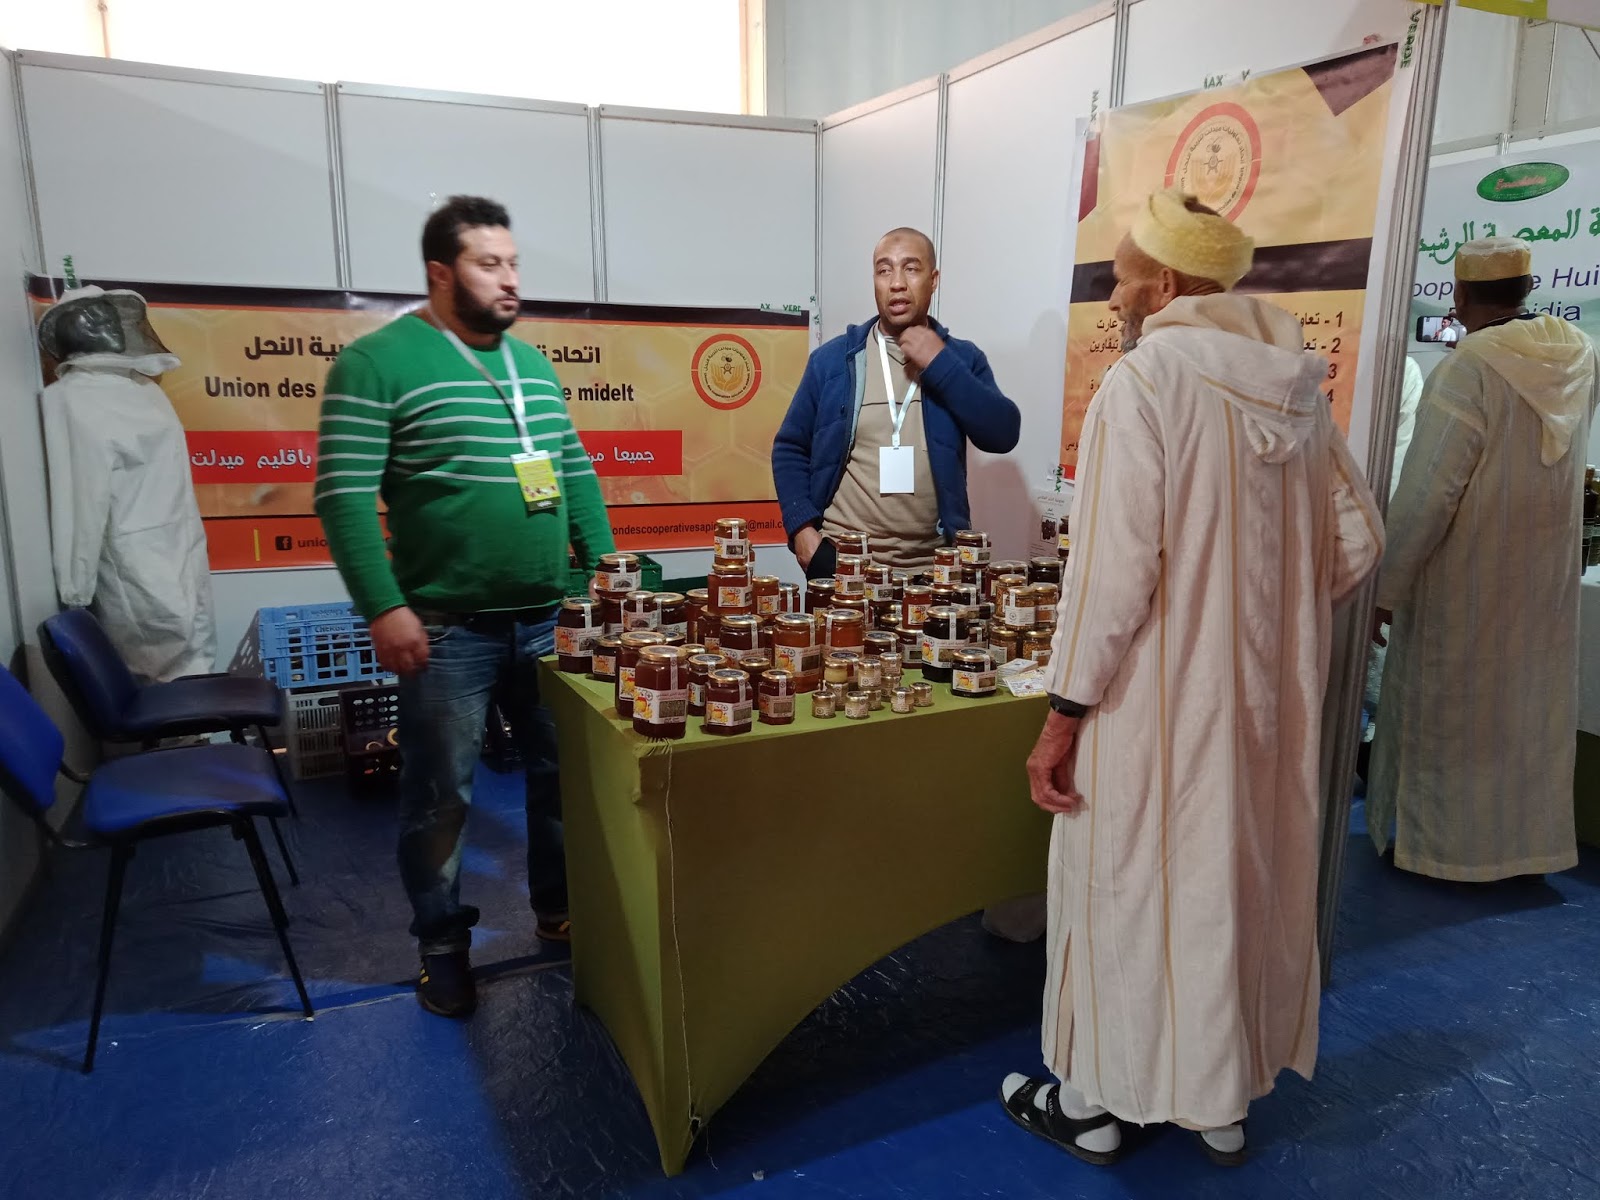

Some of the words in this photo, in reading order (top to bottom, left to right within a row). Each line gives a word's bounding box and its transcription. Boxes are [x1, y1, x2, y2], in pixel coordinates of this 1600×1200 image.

[1552, 265, 1600, 289] Hui
[244, 336, 304, 360] النحل
[1331, 337, 1341, 353] 2
[552, 346, 600, 364] اتحاد
[1328, 363, 1337, 379] 3
[204, 376, 270, 398] Union
[277, 377, 316, 398] des
[562, 387, 572, 401] e
[578, 383, 634, 401] midelt
[191, 449, 245, 469] ميدلت
[257, 449, 312, 468] باقليم
[613, 446, 655, 464] جميعا
